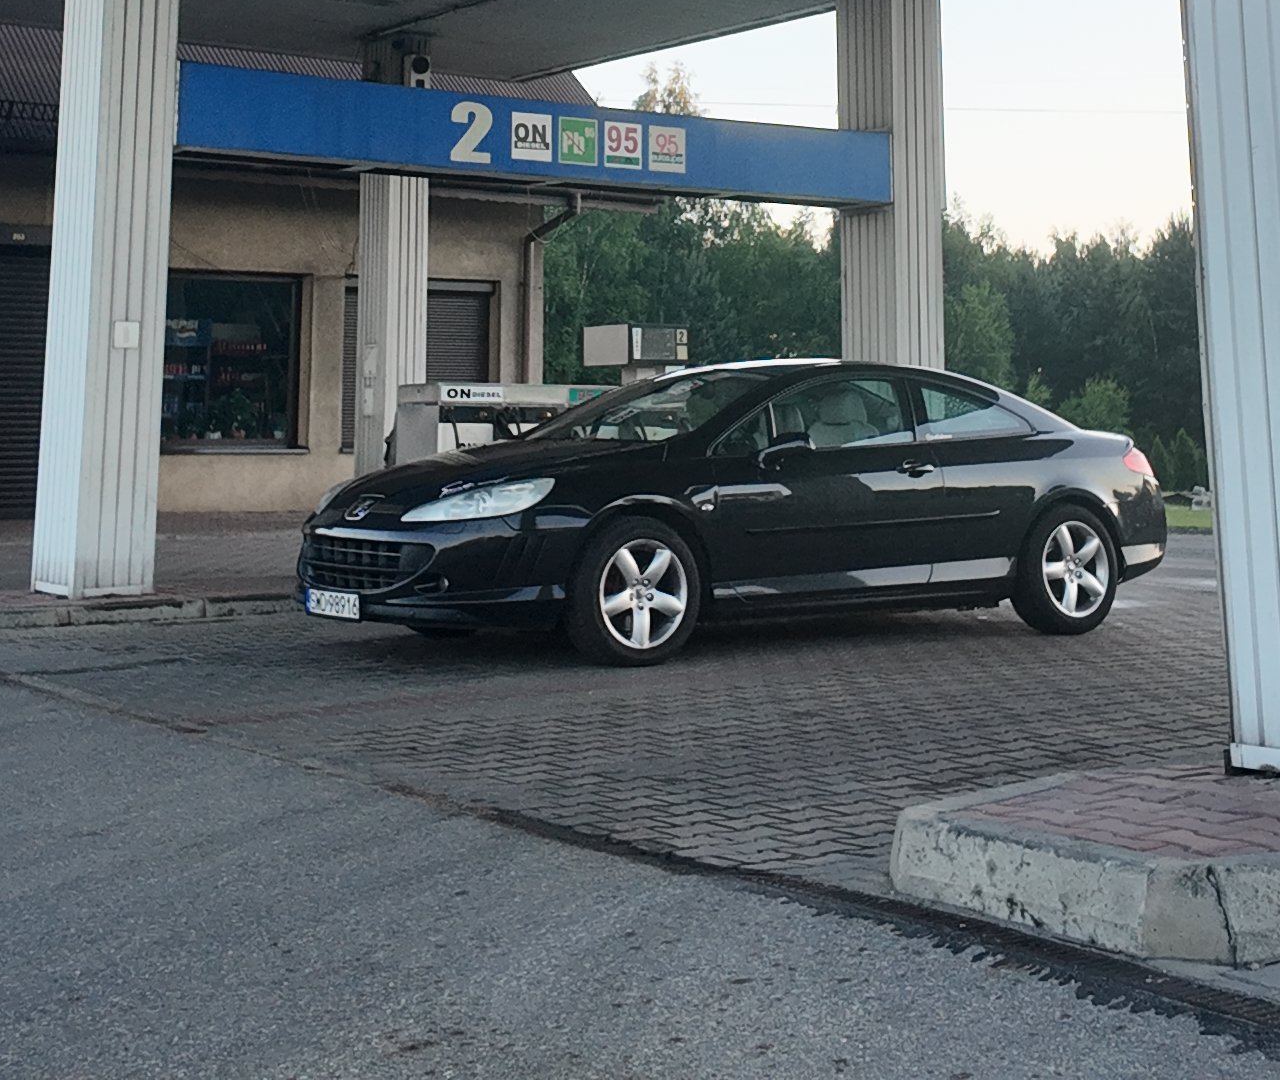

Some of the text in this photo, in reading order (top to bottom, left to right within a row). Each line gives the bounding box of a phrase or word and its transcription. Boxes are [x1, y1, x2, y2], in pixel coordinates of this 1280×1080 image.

[450, 101, 493, 163] 2
[514, 123, 548, 145] ON
[607, 125, 638, 154] 95
[655, 133, 679, 157] 95
[447, 388, 471, 399] ON
